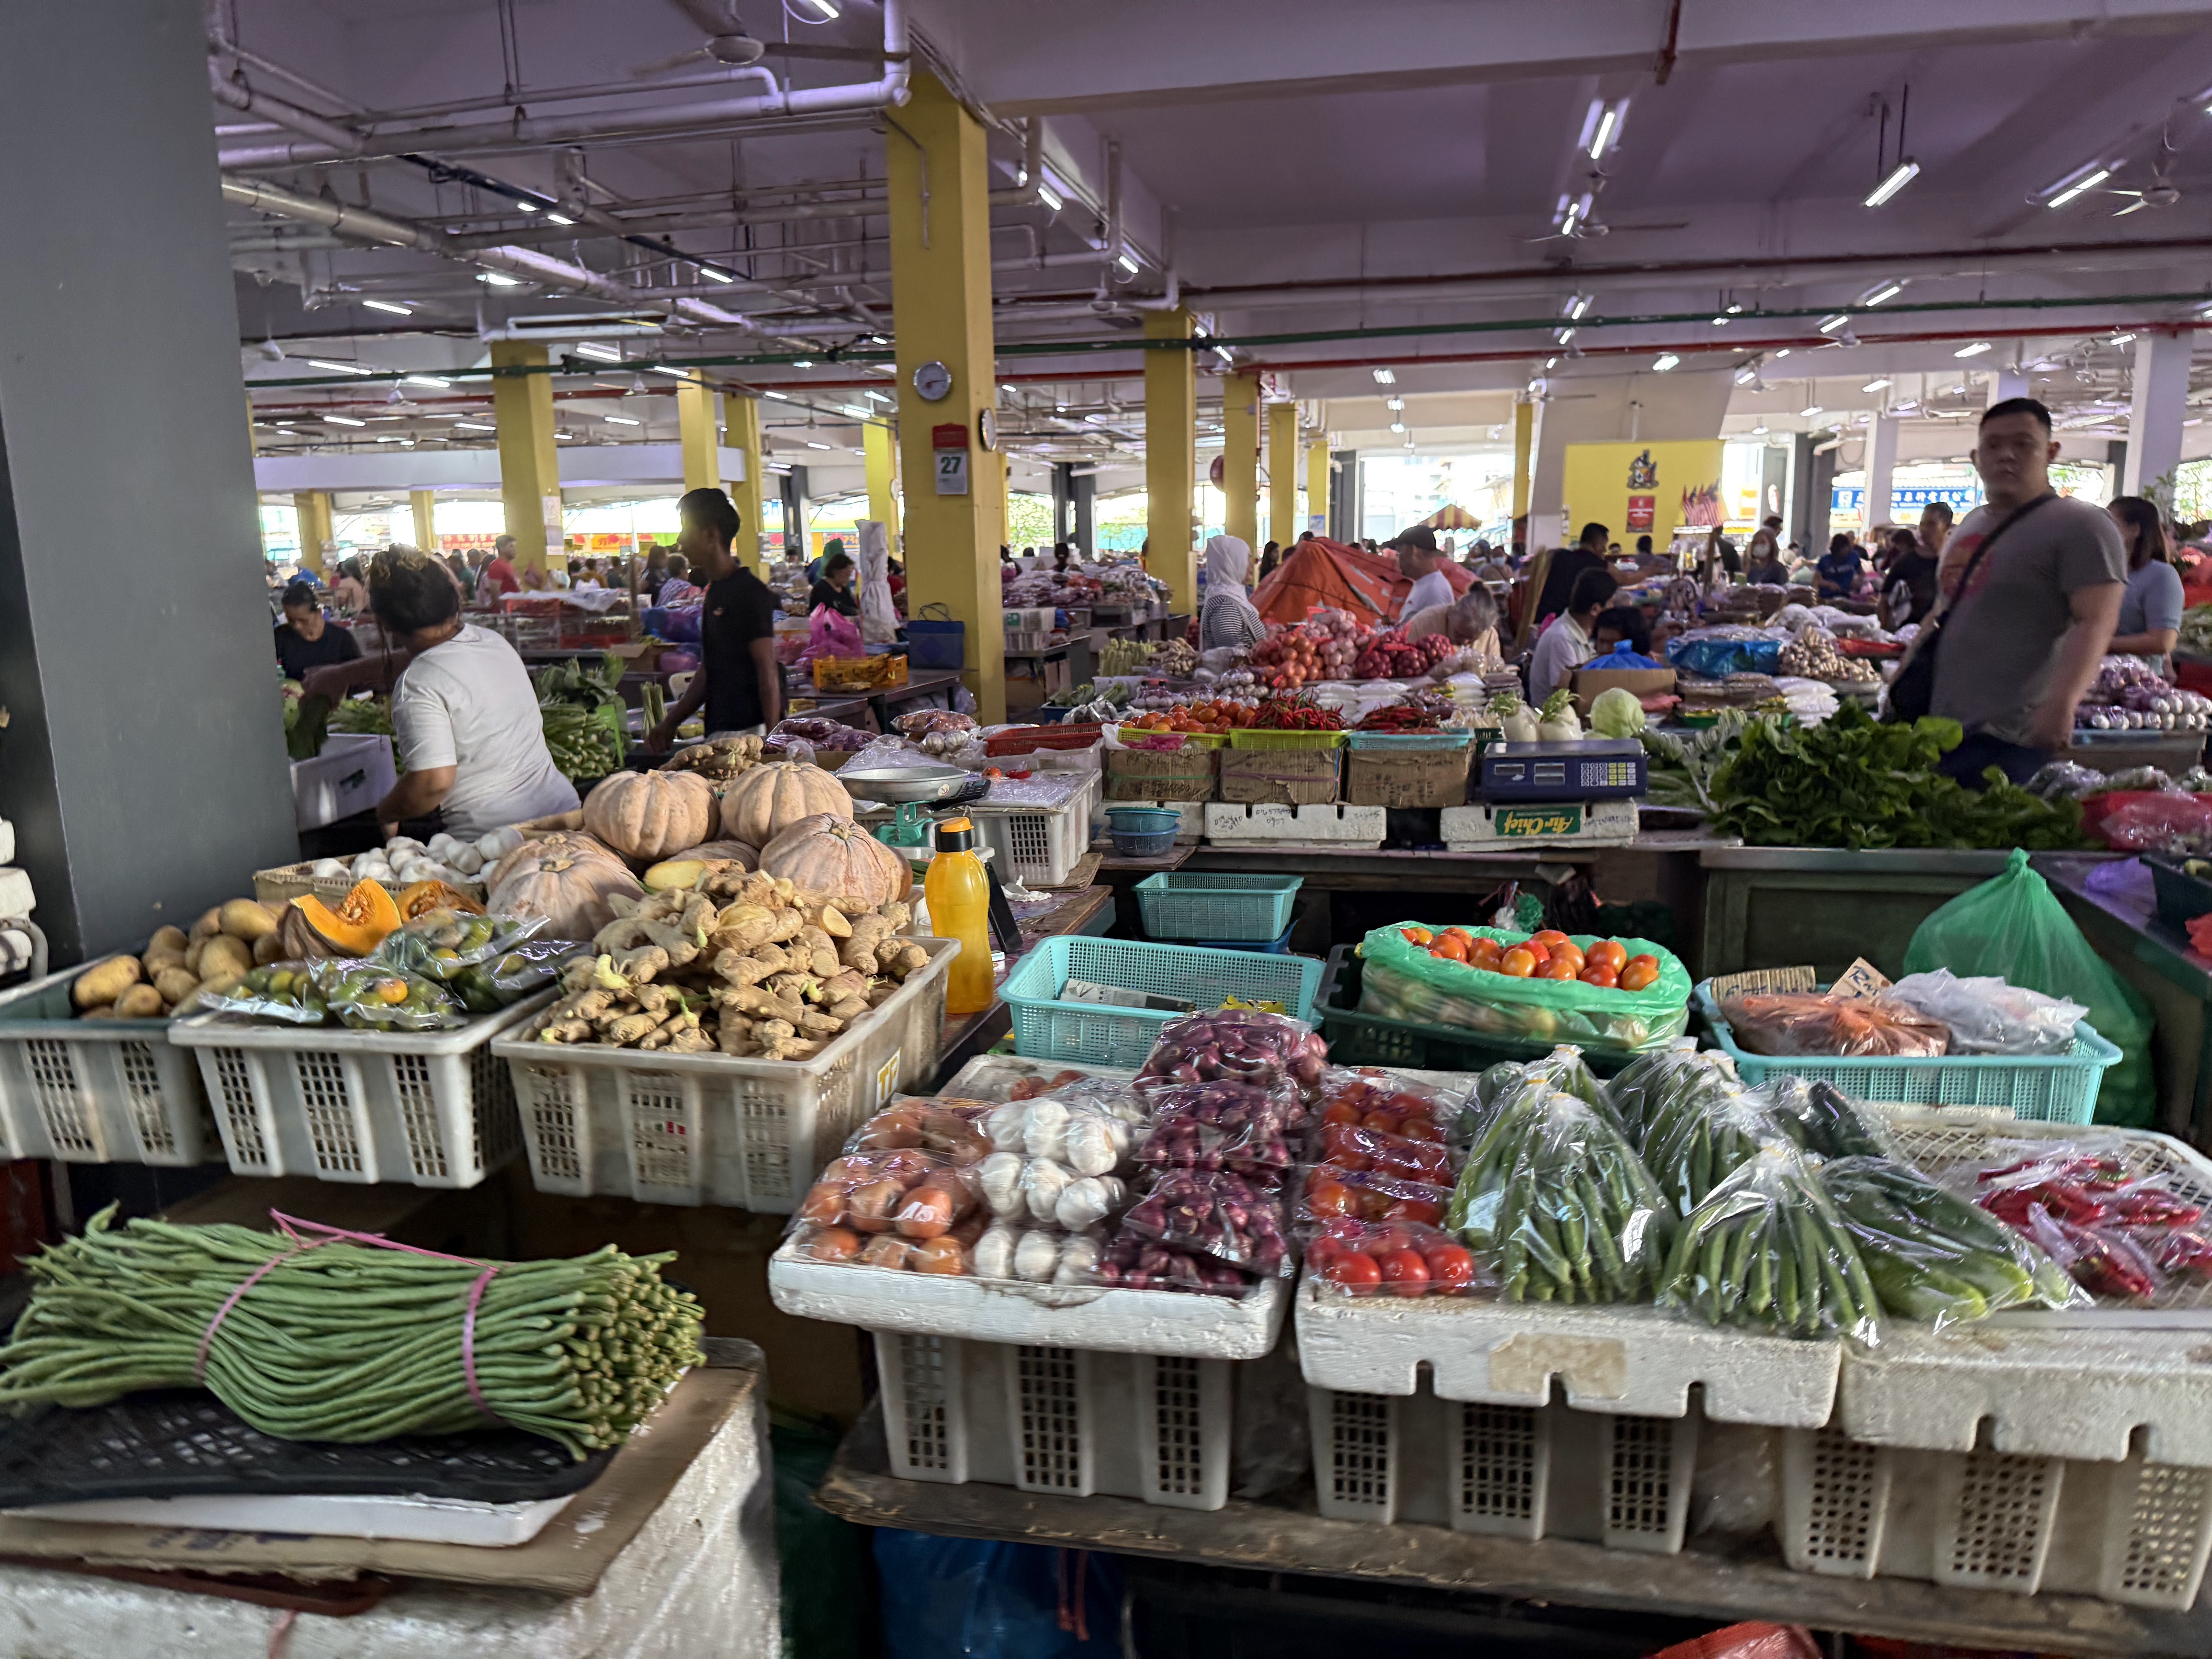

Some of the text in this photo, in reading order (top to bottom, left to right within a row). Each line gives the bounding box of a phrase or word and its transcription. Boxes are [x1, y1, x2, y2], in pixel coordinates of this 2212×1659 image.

[941, 456, 961, 474] 27
[1504, 811, 1544, 836] Chief
[1545, 816, 1574, 834] Air
